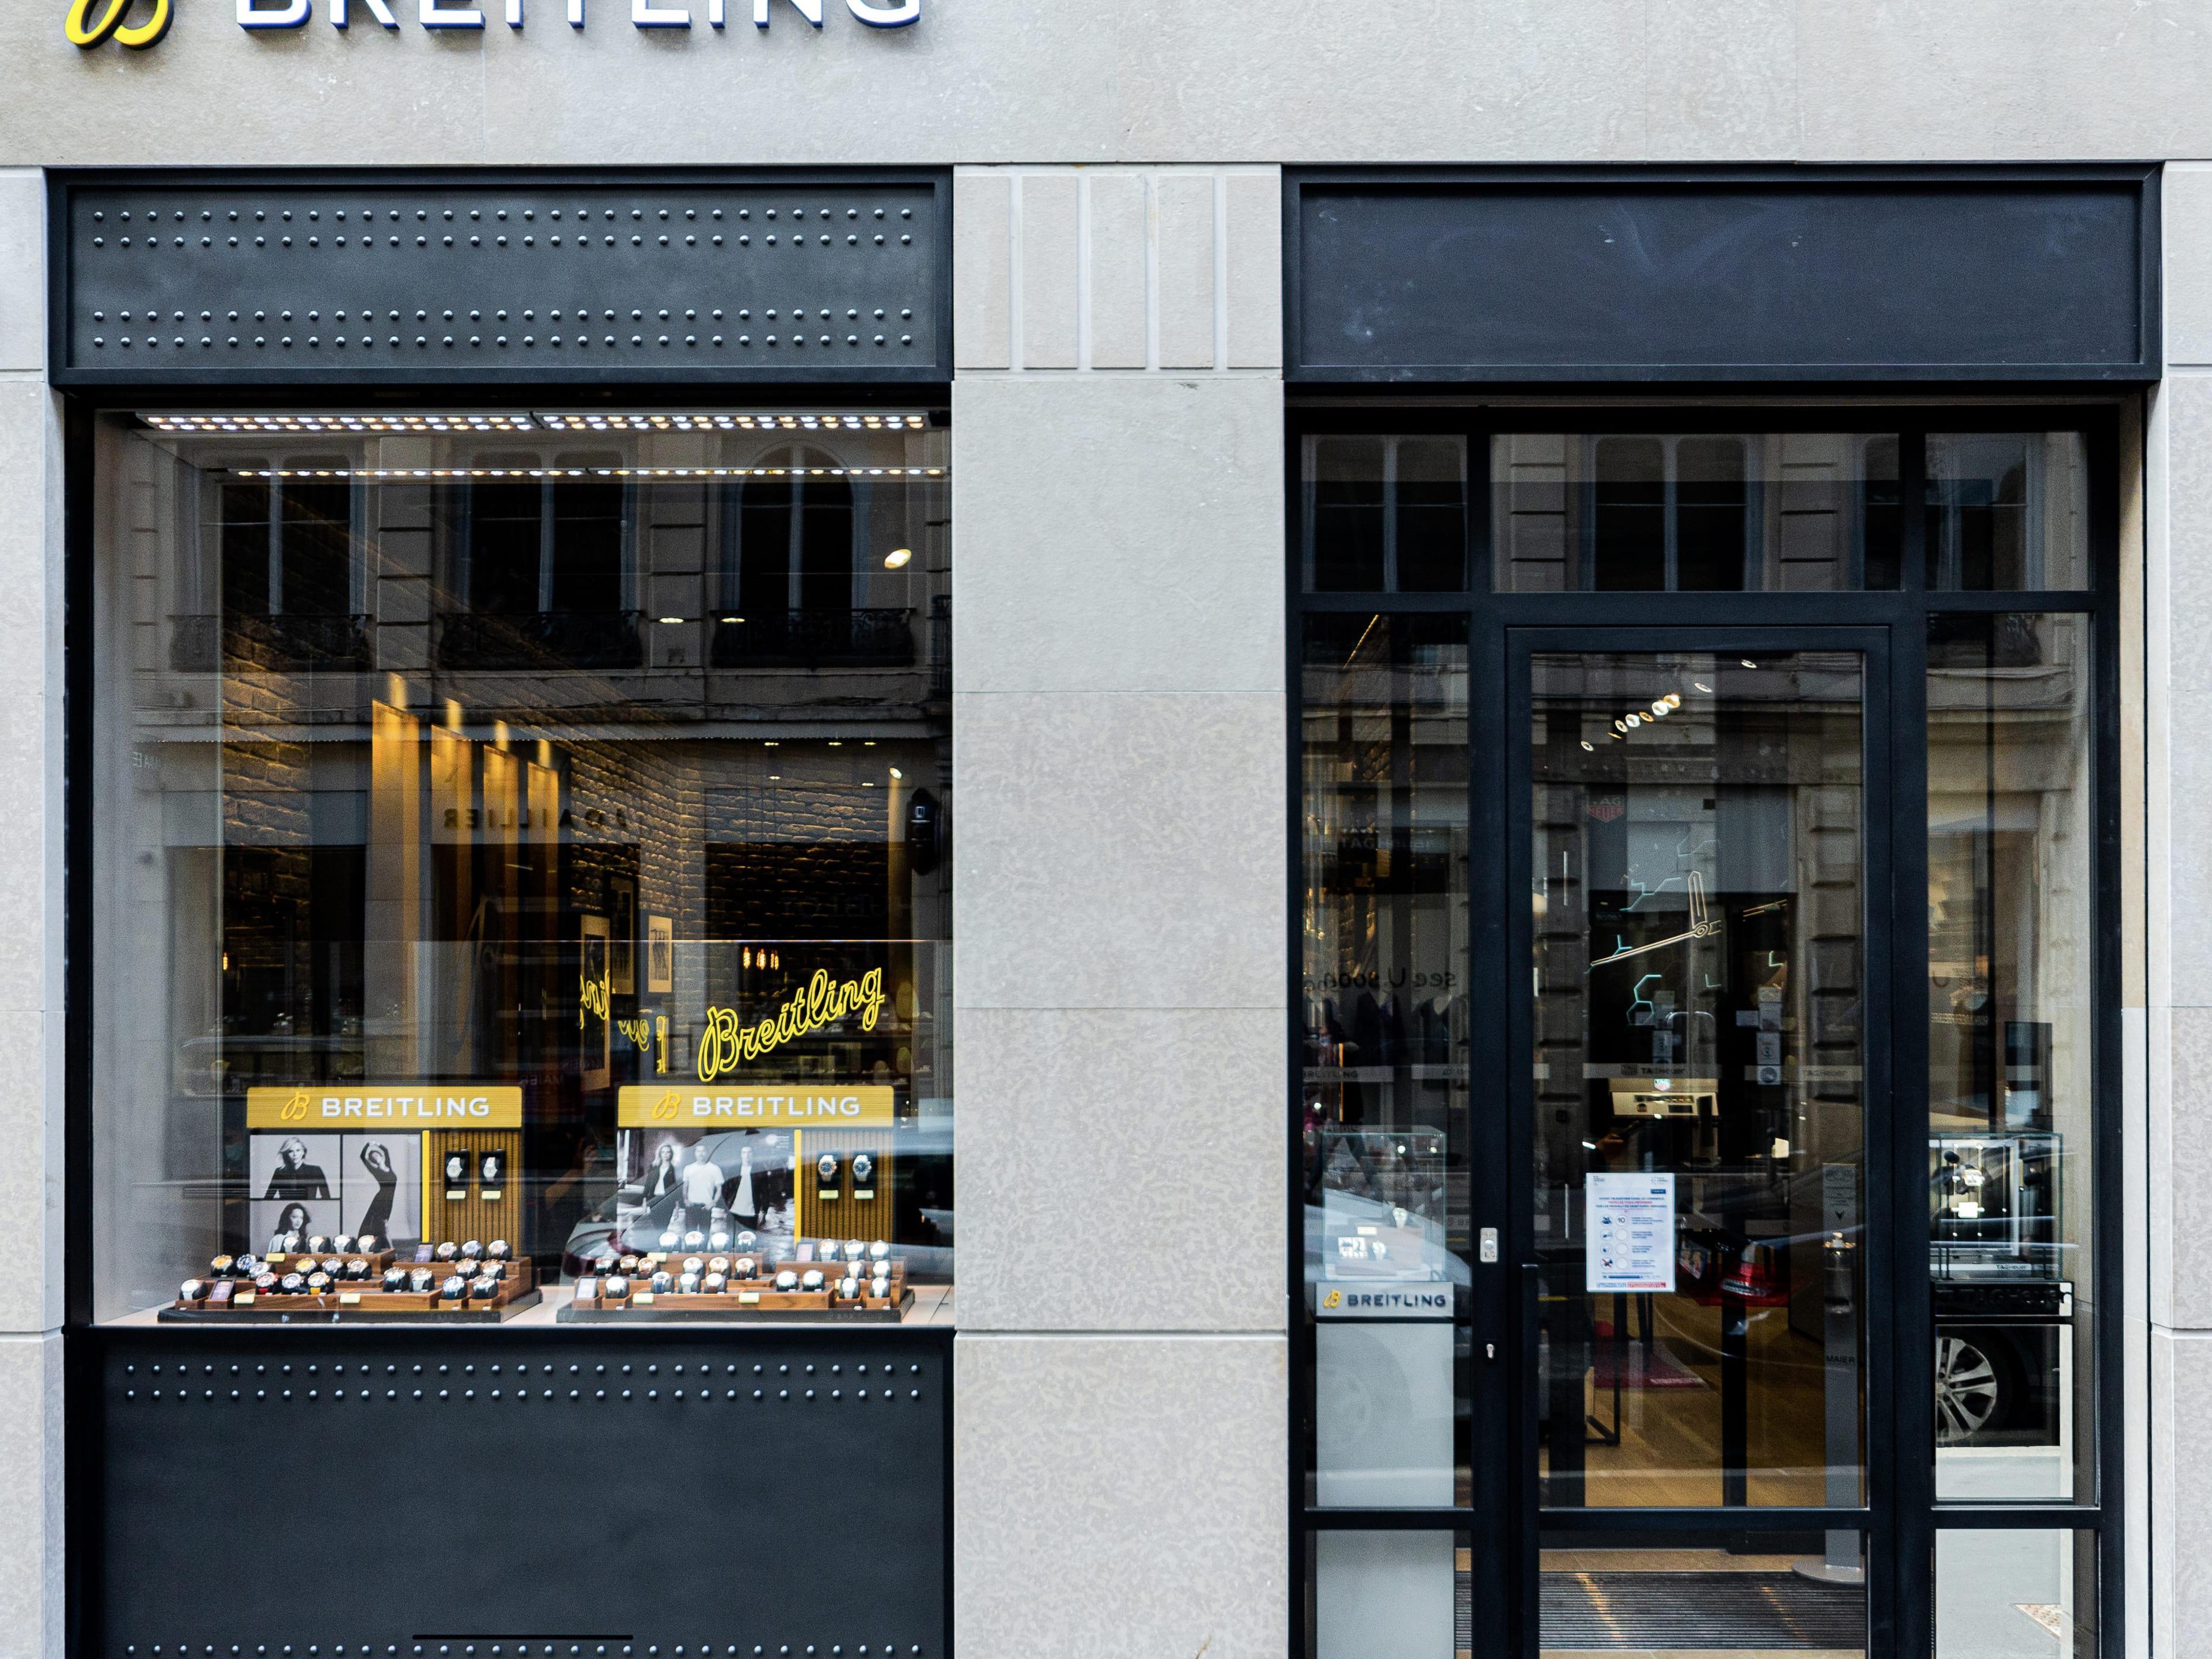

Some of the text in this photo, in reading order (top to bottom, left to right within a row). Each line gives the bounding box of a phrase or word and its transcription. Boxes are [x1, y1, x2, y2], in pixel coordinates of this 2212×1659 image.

[698, 967, 885, 1082] Breitling
[321, 1097, 490, 1117] BREITLING
[693, 1096, 861, 1116] BREITLING
[1347, 1294, 1446, 1308] BREITLING
